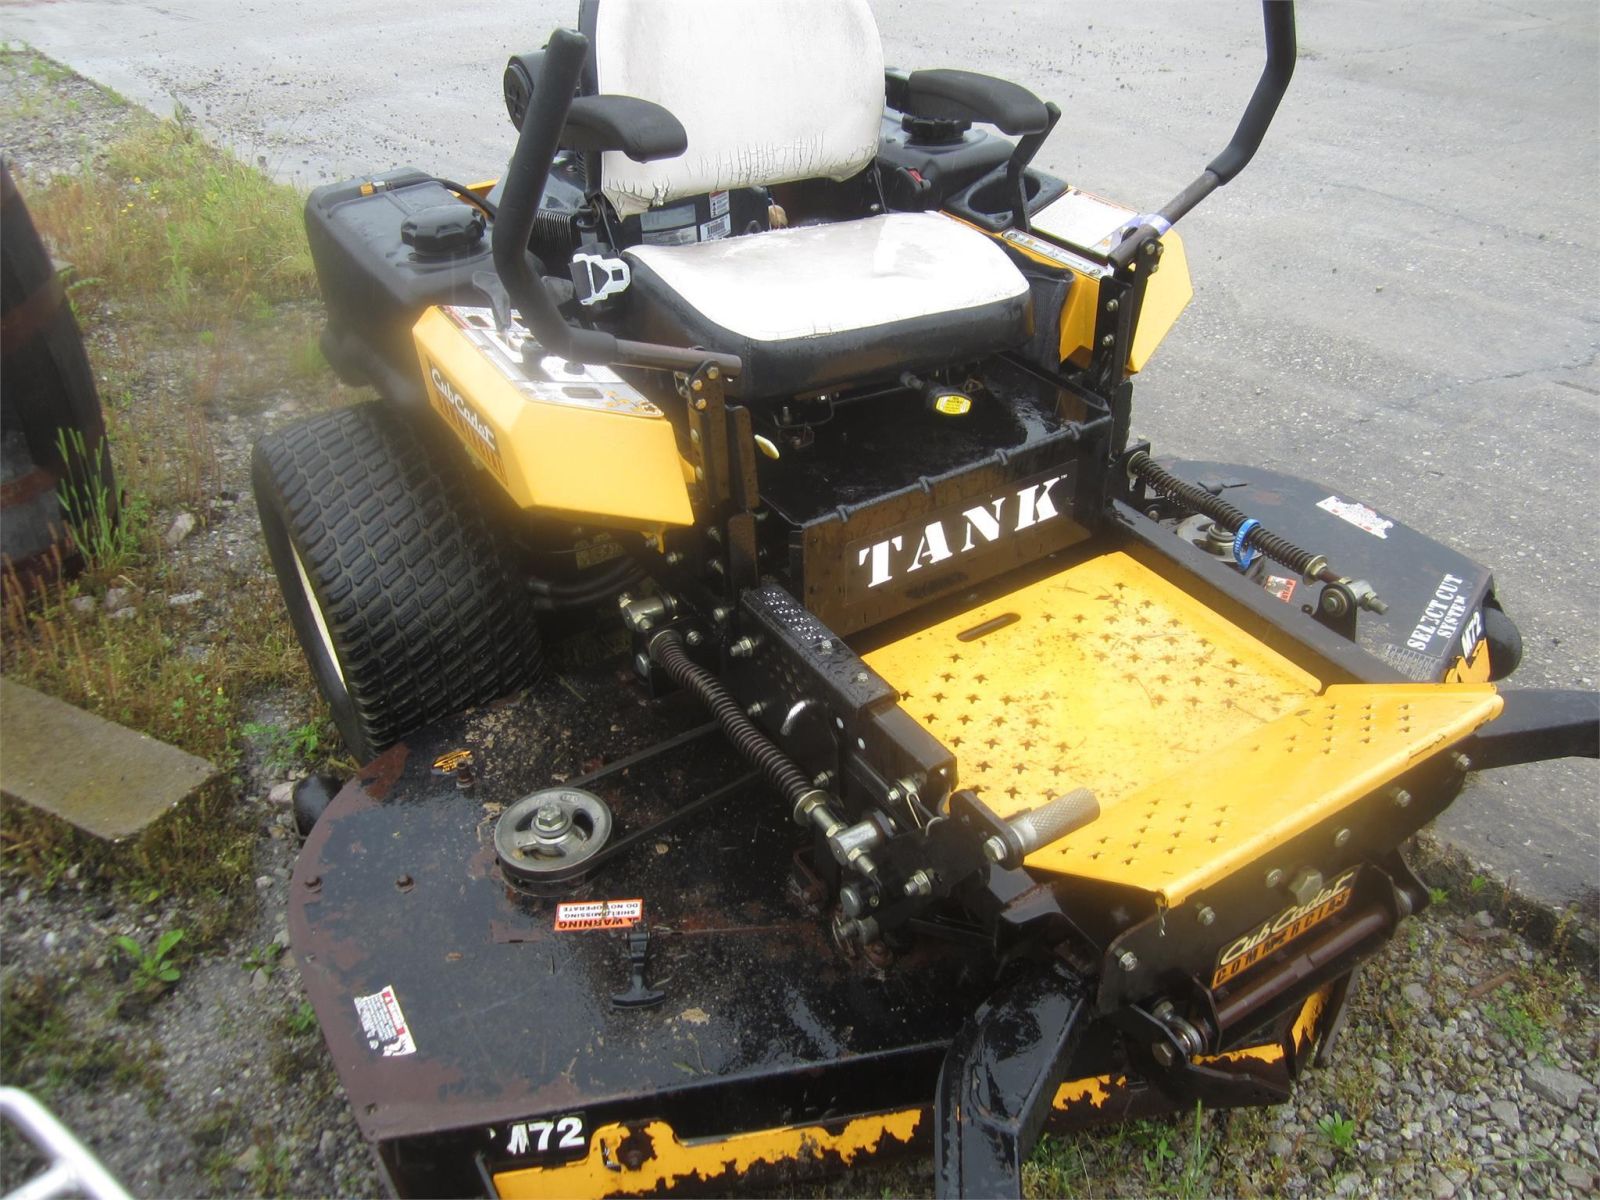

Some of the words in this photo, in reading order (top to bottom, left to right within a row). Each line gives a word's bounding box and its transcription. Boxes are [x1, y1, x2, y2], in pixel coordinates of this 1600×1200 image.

[431, 368, 455, 405] Cub
[454, 394, 496, 451] Cadet
[858, 477, 1060, 588] TANK
[1435, 573, 1463, 600] CUT
[558, 918, 624, 929] WARNING
[1216, 889, 1351, 985] COMMRCI
[1220, 922, 1271, 965] Cub
[1271, 872, 1354, 933] Cadet
